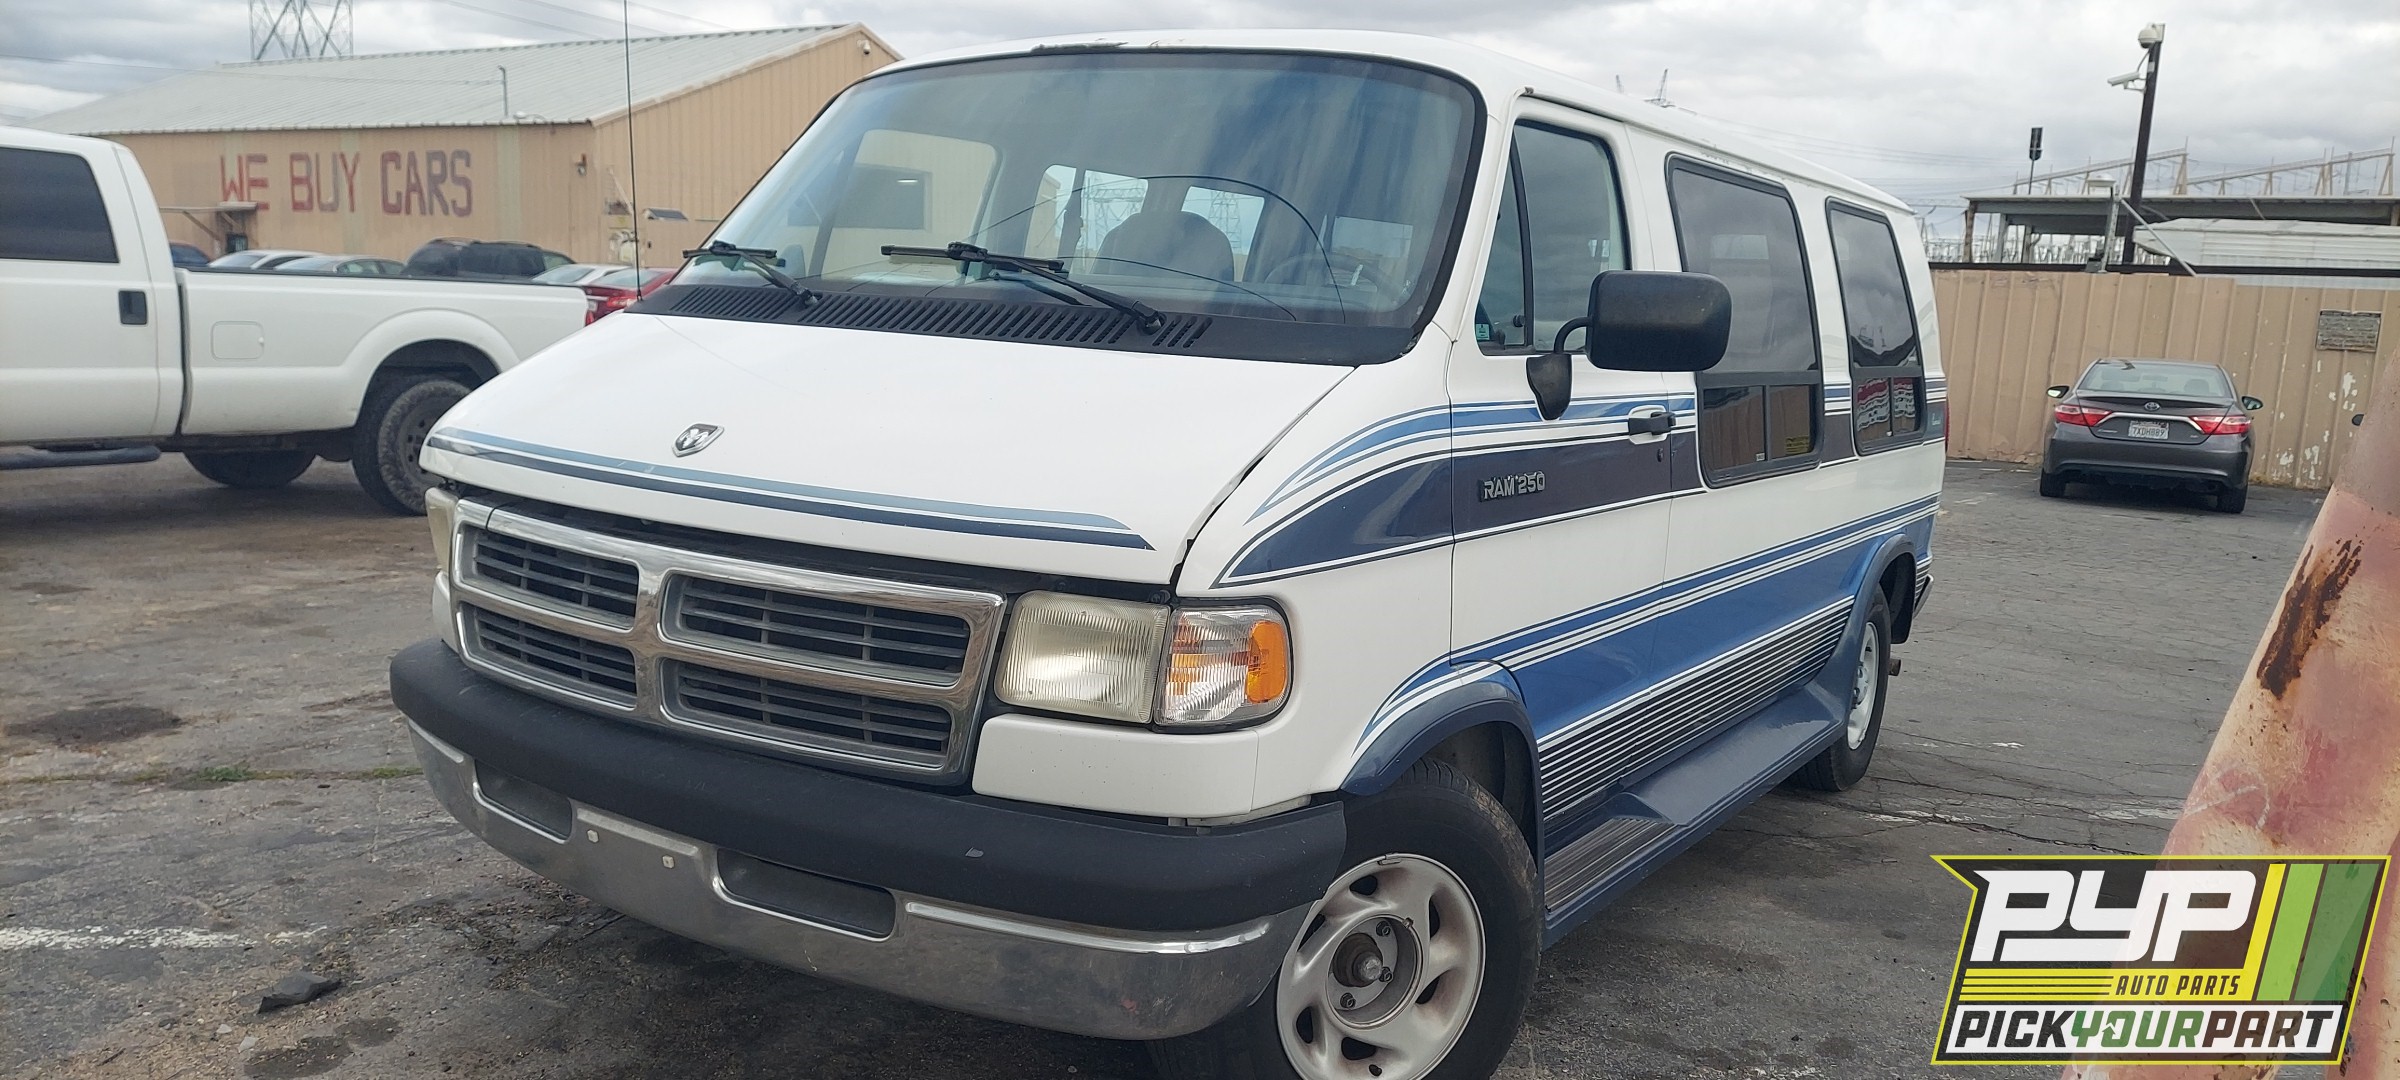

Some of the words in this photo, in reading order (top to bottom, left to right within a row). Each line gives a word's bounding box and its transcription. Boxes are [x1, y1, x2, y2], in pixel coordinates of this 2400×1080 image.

[220, 153, 270, 211] WE
[290, 151, 360, 212] BUY
[381, 150, 473, 217] CARS
[1483, 476, 1515, 500] RAM
[1518, 470, 1545, 494] 250
